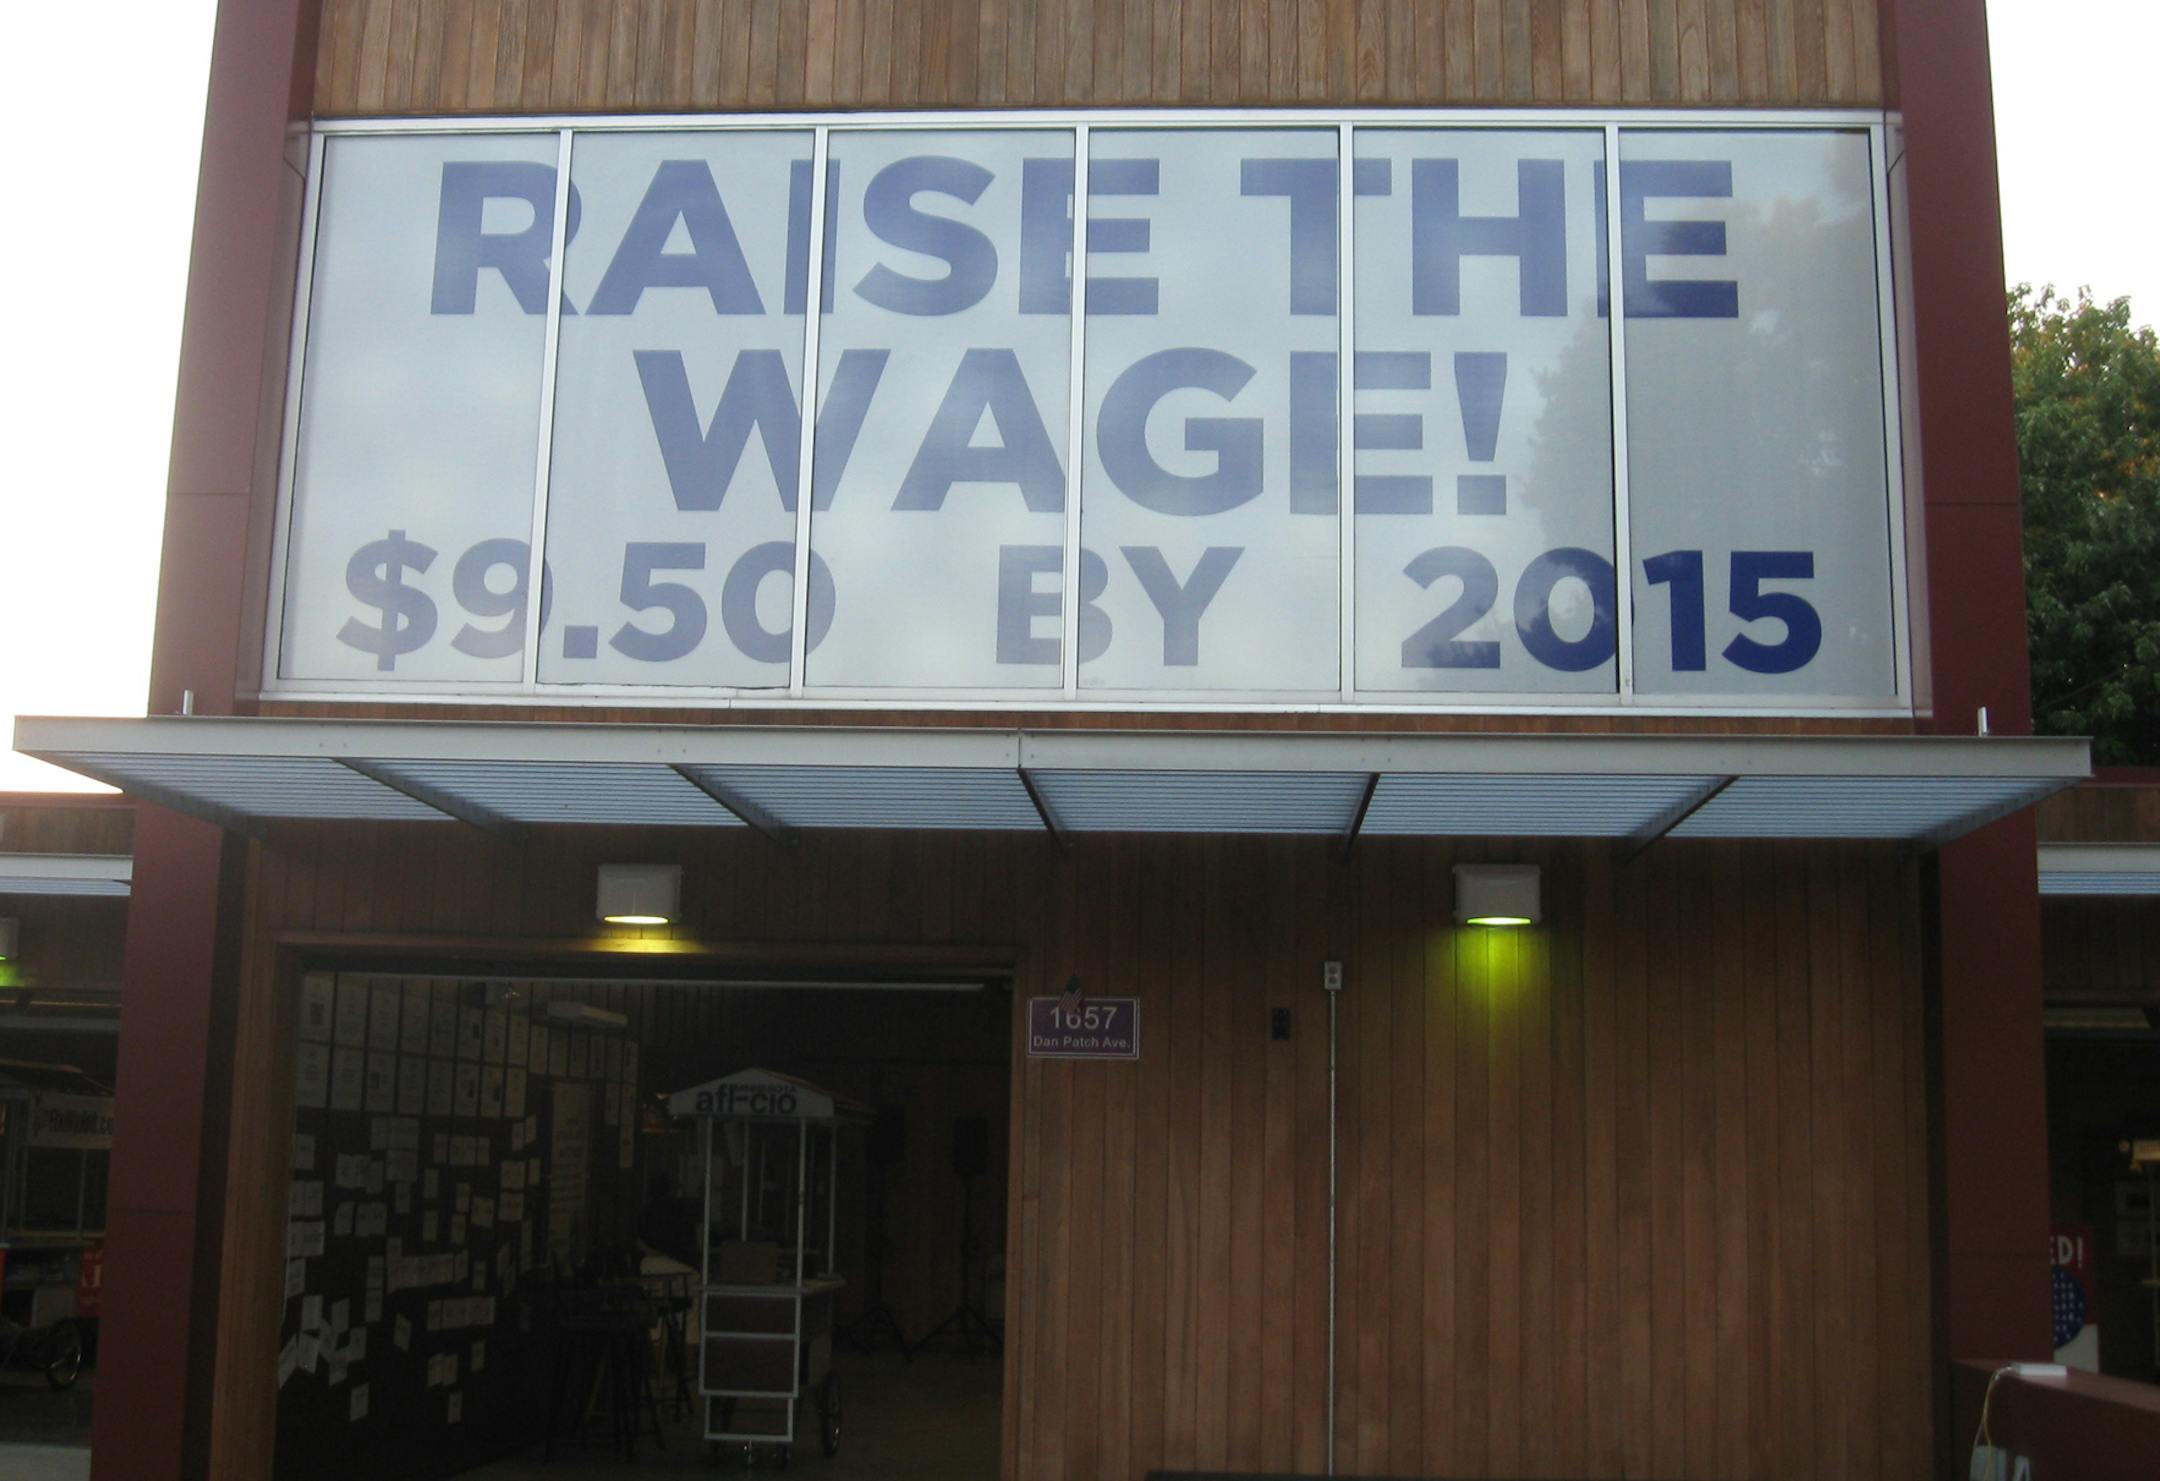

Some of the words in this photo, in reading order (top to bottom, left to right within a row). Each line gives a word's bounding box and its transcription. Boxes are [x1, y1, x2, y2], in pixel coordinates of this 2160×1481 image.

[430, 156, 1160, 316] RAISE
[1240, 157, 1740, 318] THE
[632, 346, 1508, 517] WAGE!
[336, 529, 836, 672] $9.50
[996, 545, 1246, 665] BY
[1401, 546, 1823, 675] 2015
[1033, 1035, 1059, 1048] Dan
[1063, 1035, 1099, 1048] Patch
[1102, 1036, 1131, 1049] Ave.
[1050, 1006, 1118, 1030] 1657
[2050, 1235, 2084, 1269] D!
